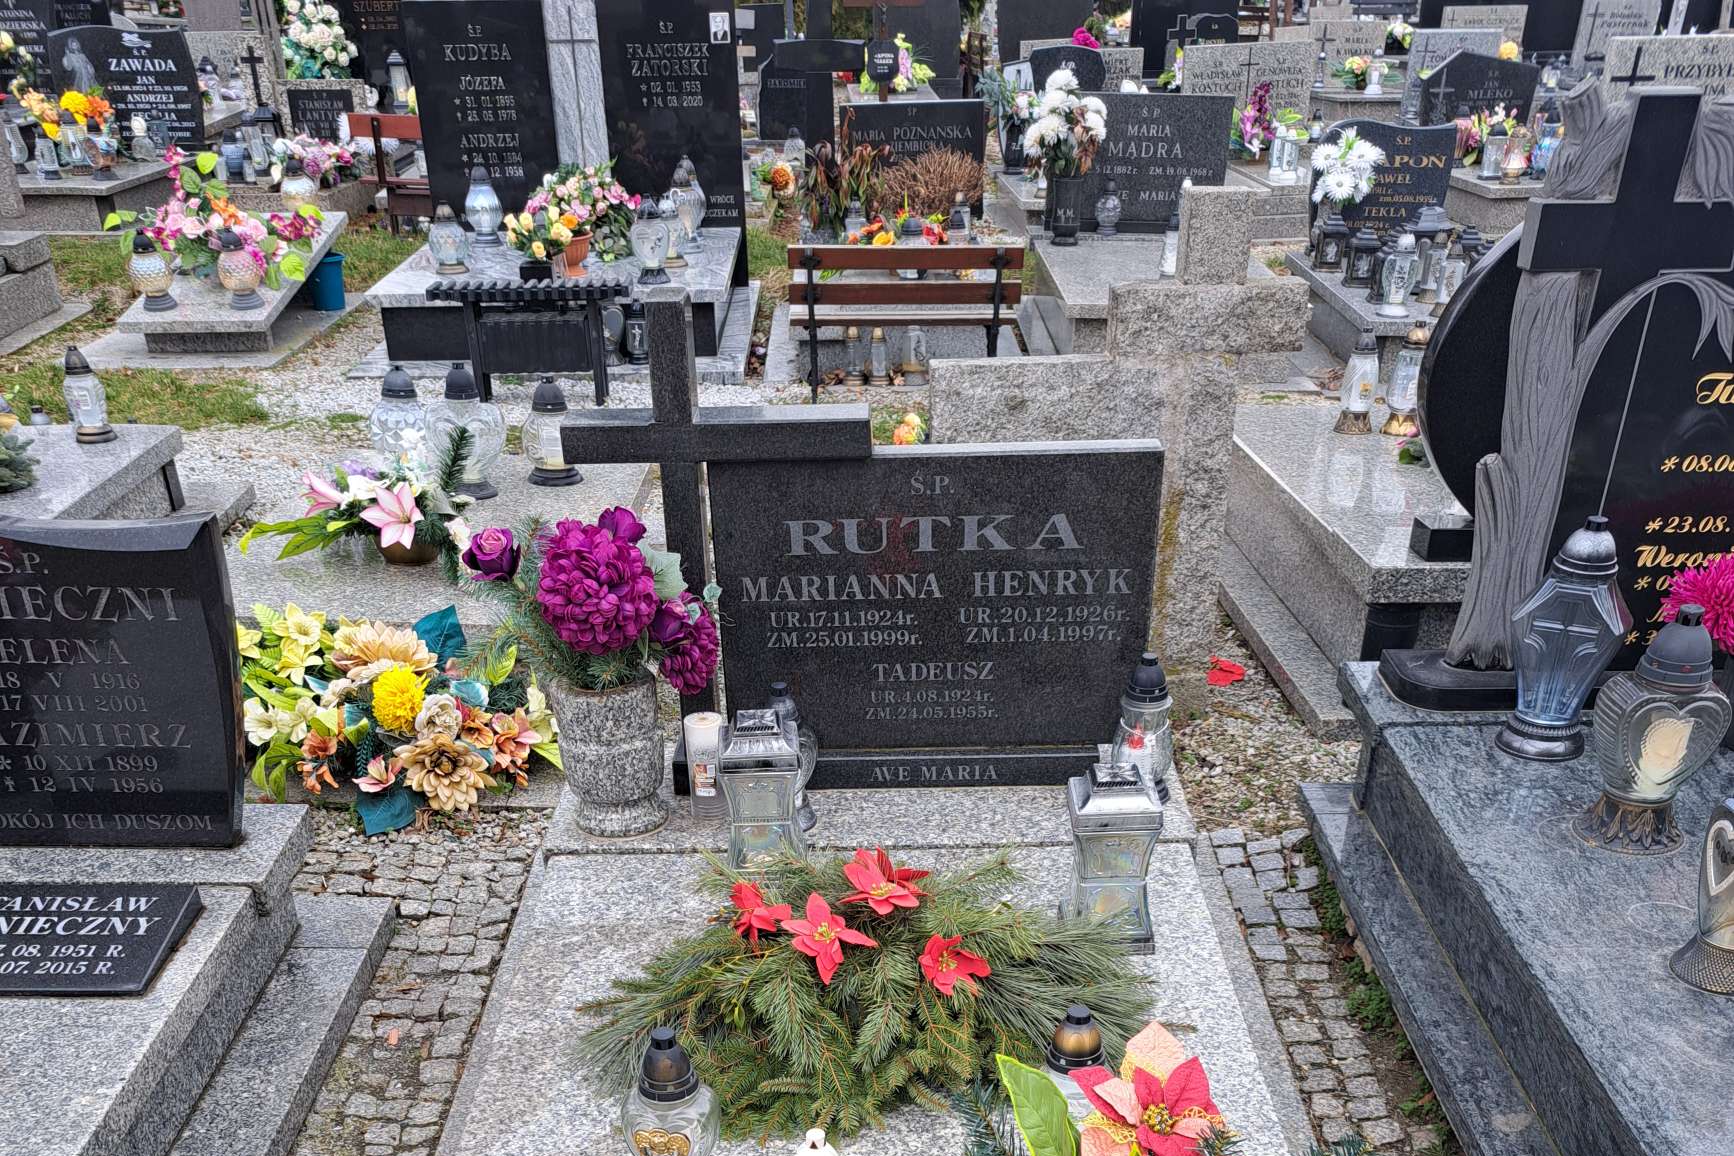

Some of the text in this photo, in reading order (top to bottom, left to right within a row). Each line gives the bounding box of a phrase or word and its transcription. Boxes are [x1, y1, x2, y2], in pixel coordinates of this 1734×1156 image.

[441, 43, 512, 61] KUDYBA
[626, 43, 710, 58] FRANCISZEK
[108, 58, 177, 72] ZAWADA
[631, 59, 709, 77] ZATORSKI
[136, 75, 156, 84] JAN
[460, 74, 506, 91] JÓZEFA
[127, 93, 174, 103] ANDRZEJ
[853, 130, 886, 142] MARIA
[1127, 124, 1171, 137] MARIA
[460, 133, 520, 148] ANDRZEJ
[1107, 141, 1182, 160] MĄDRA
[1382, 153, 1448, 169] APOŃ
[1376, 173, 1413, 184] AWEŁ
[705, 208, 740, 218] OCZEKAM
[1363, 206, 1407, 217] TEKLA
[1663, 516, 1731, 533] 23.08.
[783, 513, 1085, 556] RUTKA
[741, 572, 944, 602] MARIANNA
[974, 568, 1132, 599] HENRYK
[872, 660, 995, 683] TADEUSZ
[47, 671, 63, 689] V
[90, 671, 141, 690] 1916
[31, 694, 87, 712] VIII
[94, 694, 149, 713] 2001
[23, 754, 159, 772] 10 XII 1899
[870, 764, 998, 782] AVE MARIA
[30, 776, 164, 794] 12 IV 1956
[62, 813, 105, 830] ICH
[113, 813, 215, 831] DUSZOM
[11, 944, 42, 957] 08.
[48, 944, 98, 957] 1951
[104, 944, 126, 957] R.
[33, 961, 89, 975] 2015
[92, 961, 116, 975] R.
